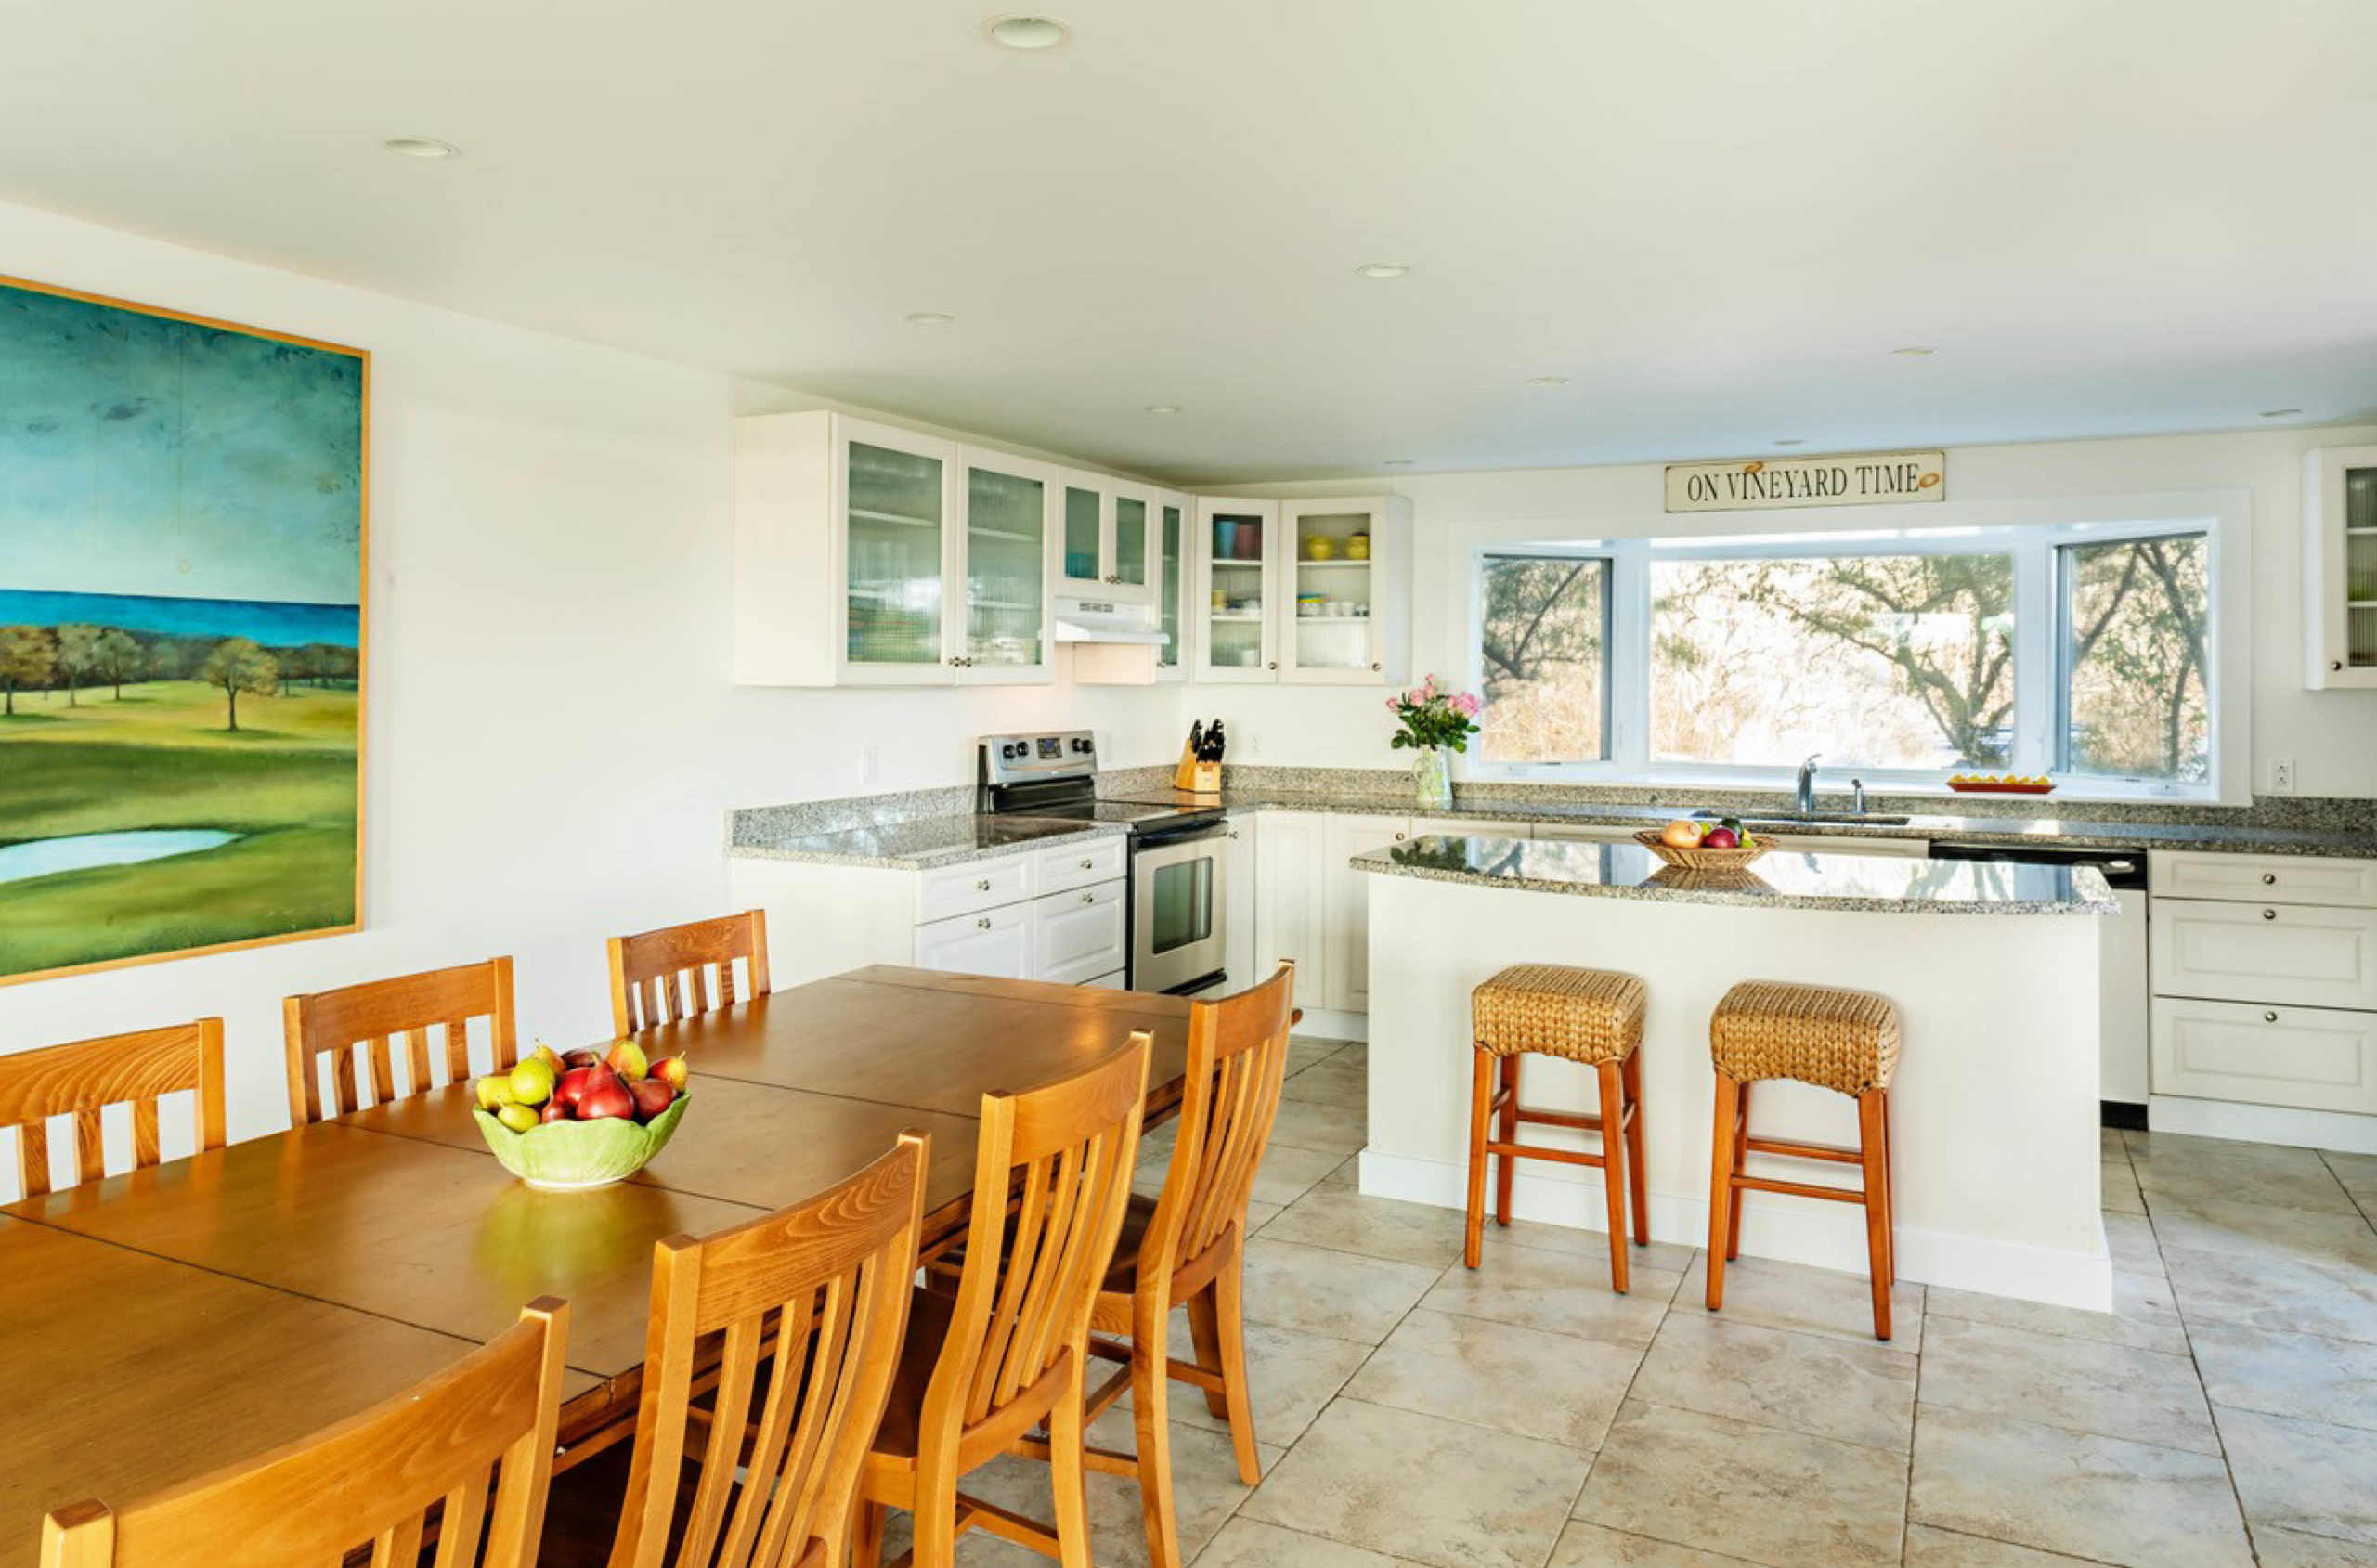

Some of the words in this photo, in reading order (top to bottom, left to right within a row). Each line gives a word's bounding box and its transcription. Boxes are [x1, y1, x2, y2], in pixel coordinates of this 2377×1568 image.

[1687, 473, 1719, 502] ON
[1727, 467, 1848, 499] VINEYARD
[1855, 463, 1920, 494] TIME
